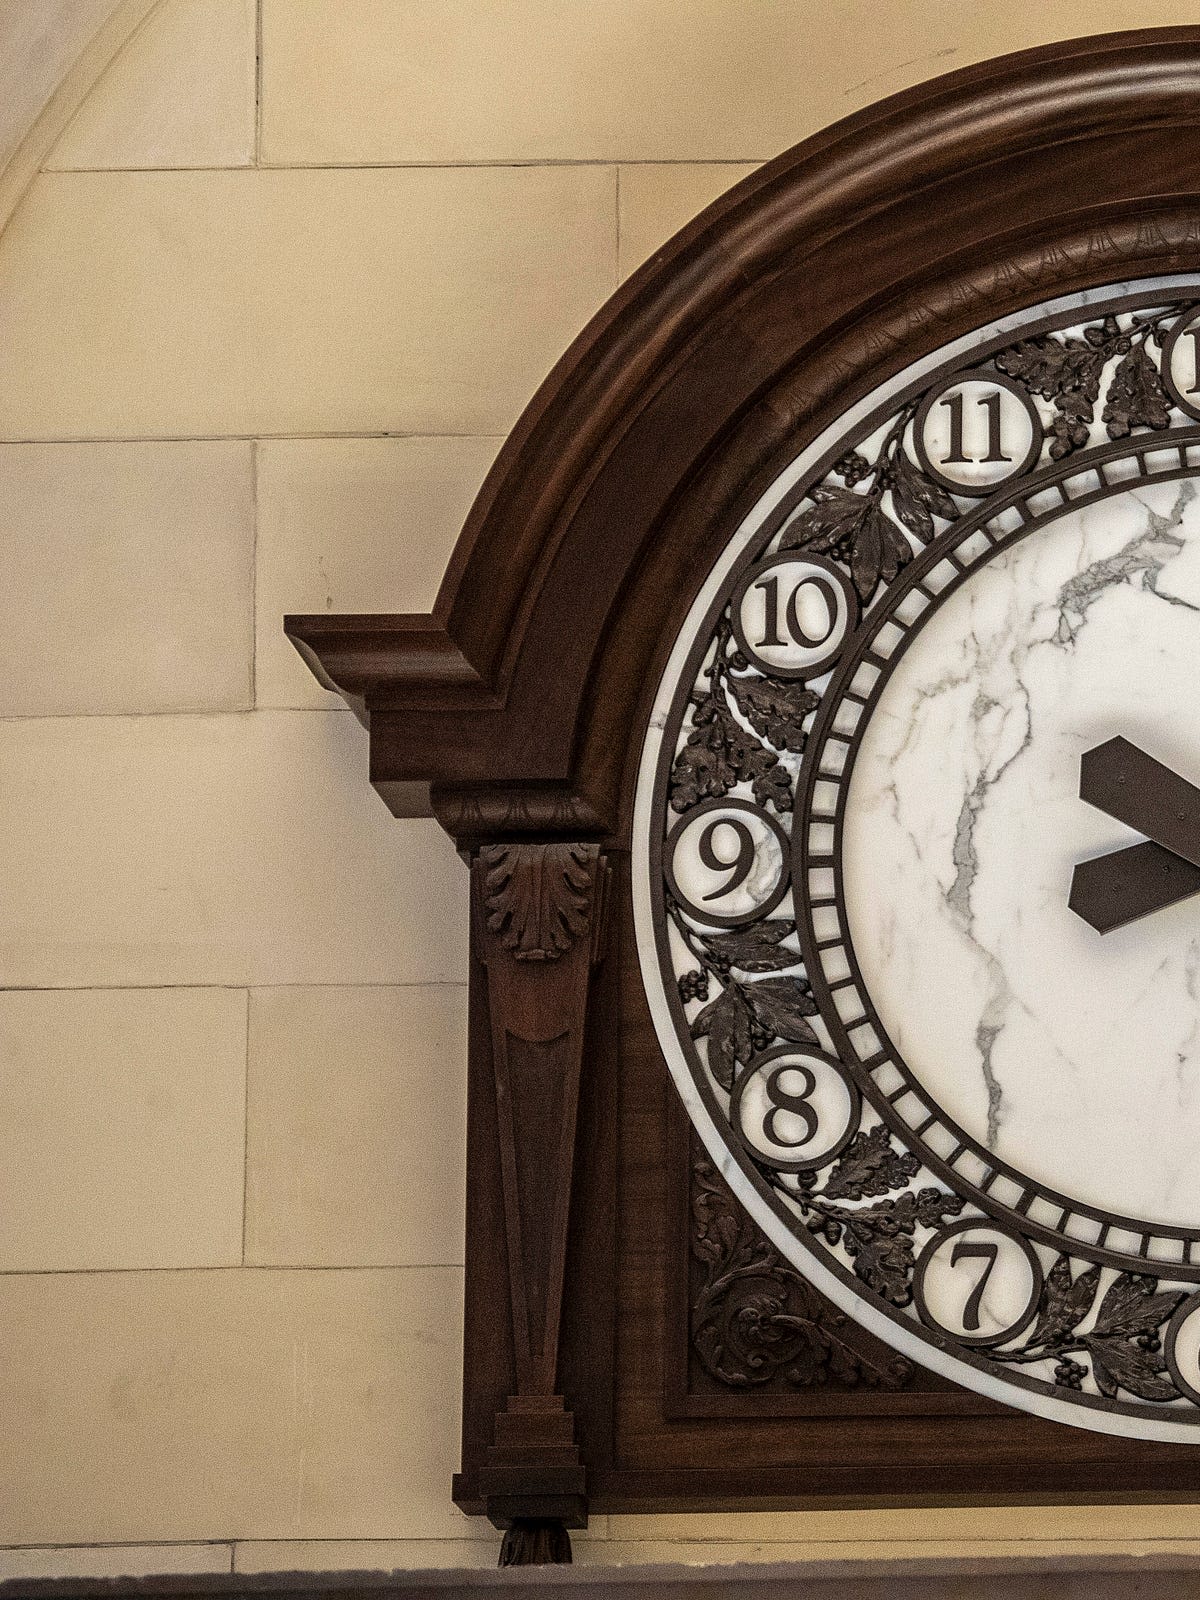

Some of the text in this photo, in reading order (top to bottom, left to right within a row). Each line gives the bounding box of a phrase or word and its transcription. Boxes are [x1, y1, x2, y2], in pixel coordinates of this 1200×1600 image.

[940, 392, 1012, 465] 11
[755, 576, 838, 649] 10
[699, 818, 756, 901] 9
[763, 1064, 818, 1147] 8
[951, 1242, 998, 1331] 7
